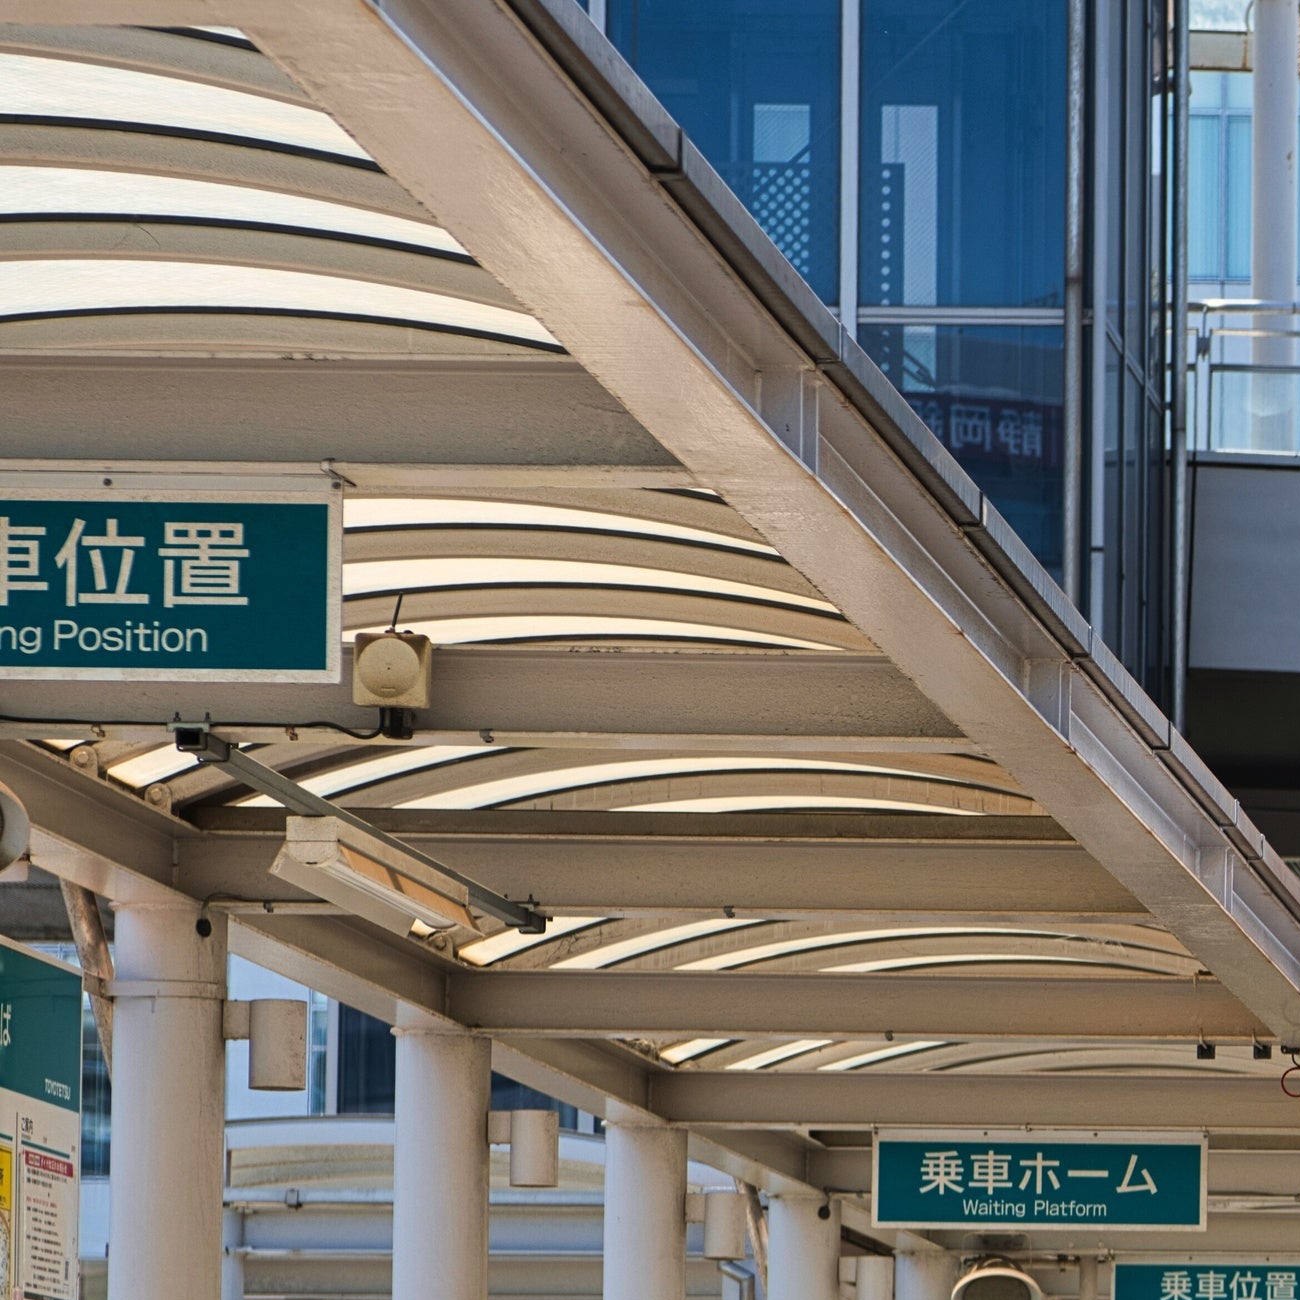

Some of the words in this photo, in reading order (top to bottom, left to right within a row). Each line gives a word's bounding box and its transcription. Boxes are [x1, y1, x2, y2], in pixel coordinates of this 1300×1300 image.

[53, 619, 208, 652] Position
[919, 1150, 1159, 1195] 乗車ホーム
[963, 1199, 1026, 1218] Waiting
[1034, 1200, 1107, 1217] Platform
